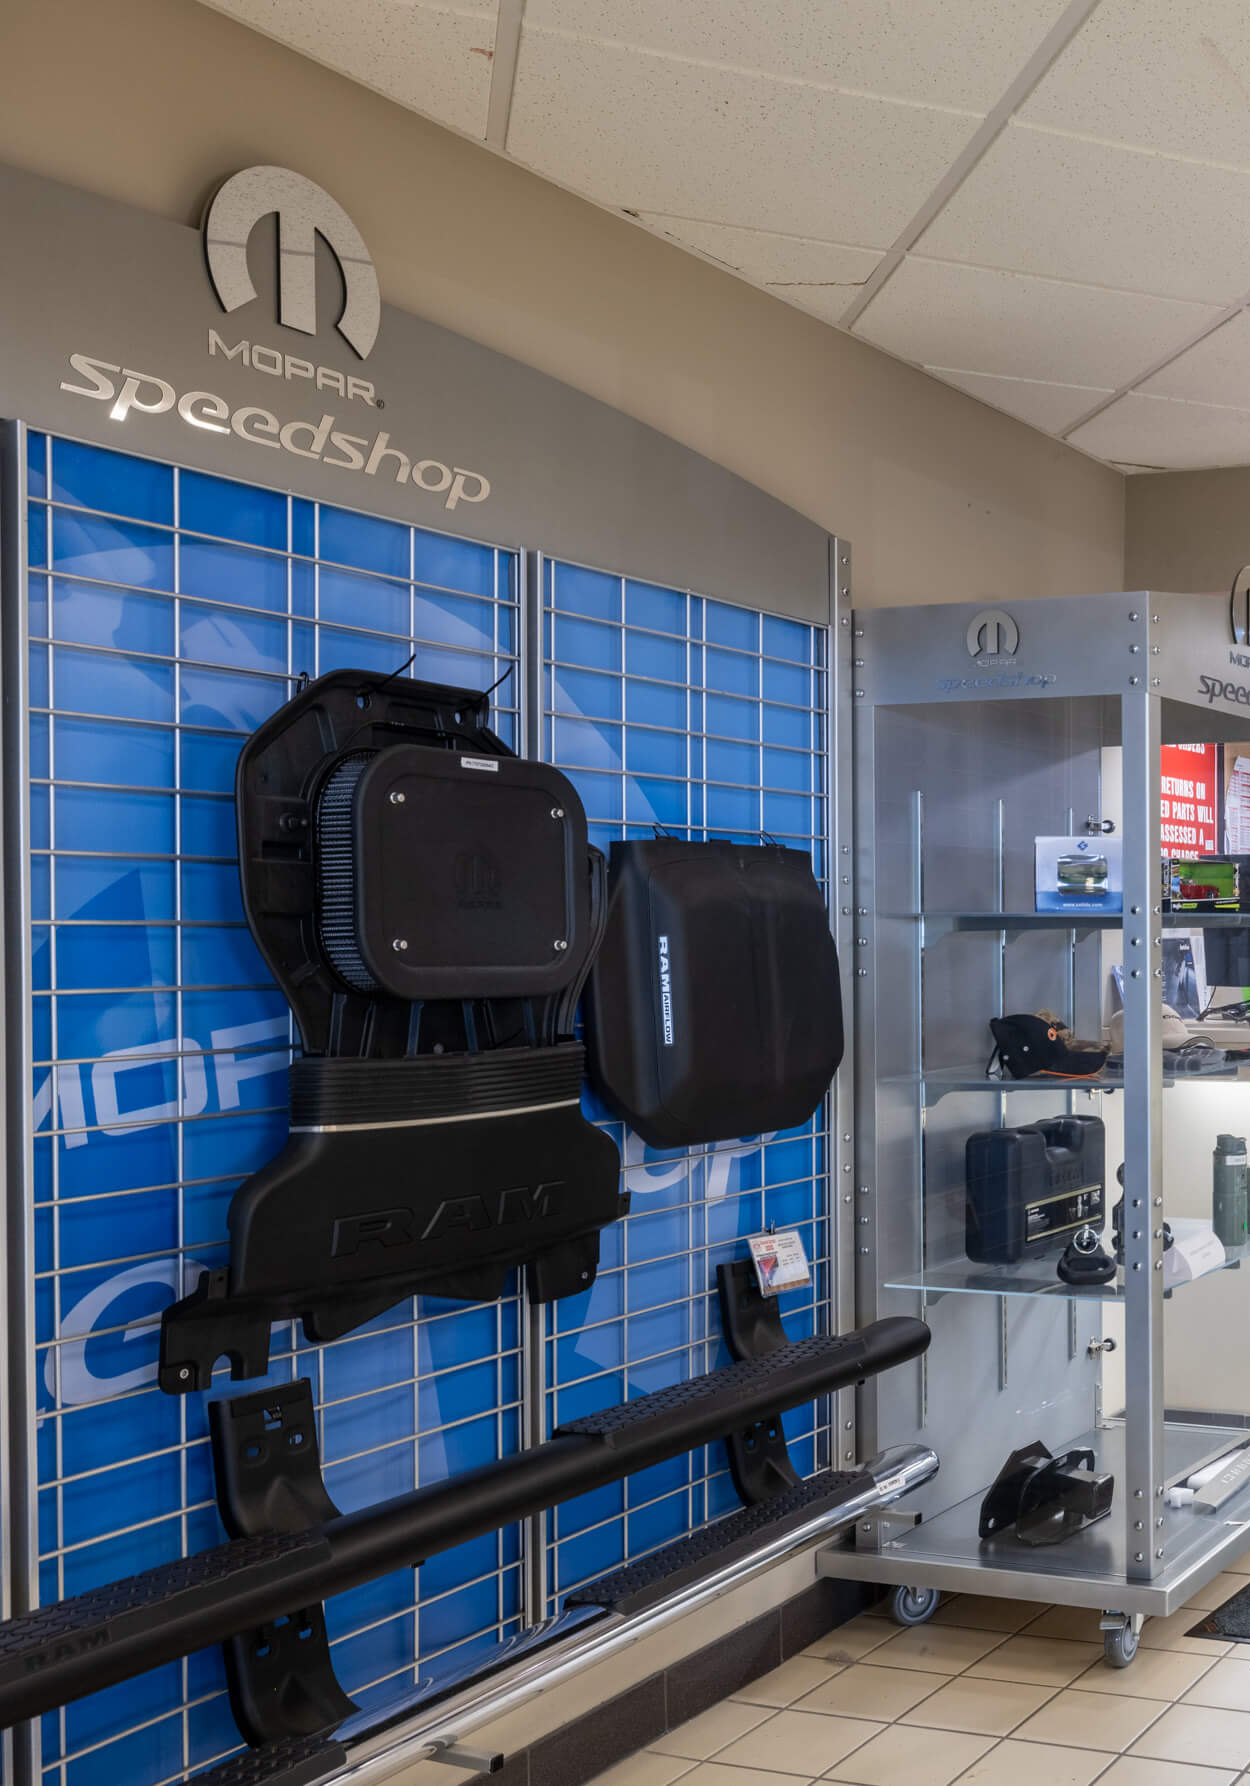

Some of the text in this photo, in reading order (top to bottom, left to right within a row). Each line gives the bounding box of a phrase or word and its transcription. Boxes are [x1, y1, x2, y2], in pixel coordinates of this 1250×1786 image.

[208, 328, 378, 408] MOPAR
[1172, 801, 1195, 822] PARTS
[1197, 805, 1214, 824] WILL
[1196, 782, 1206, 801] ON
[1161, 823, 1197, 845] ASSESSED
[1199, 828, 1205, 846] A
[659, 936, 673, 1044] RAM AIRFLOW
[330, 1178, 568, 1260] RAM
